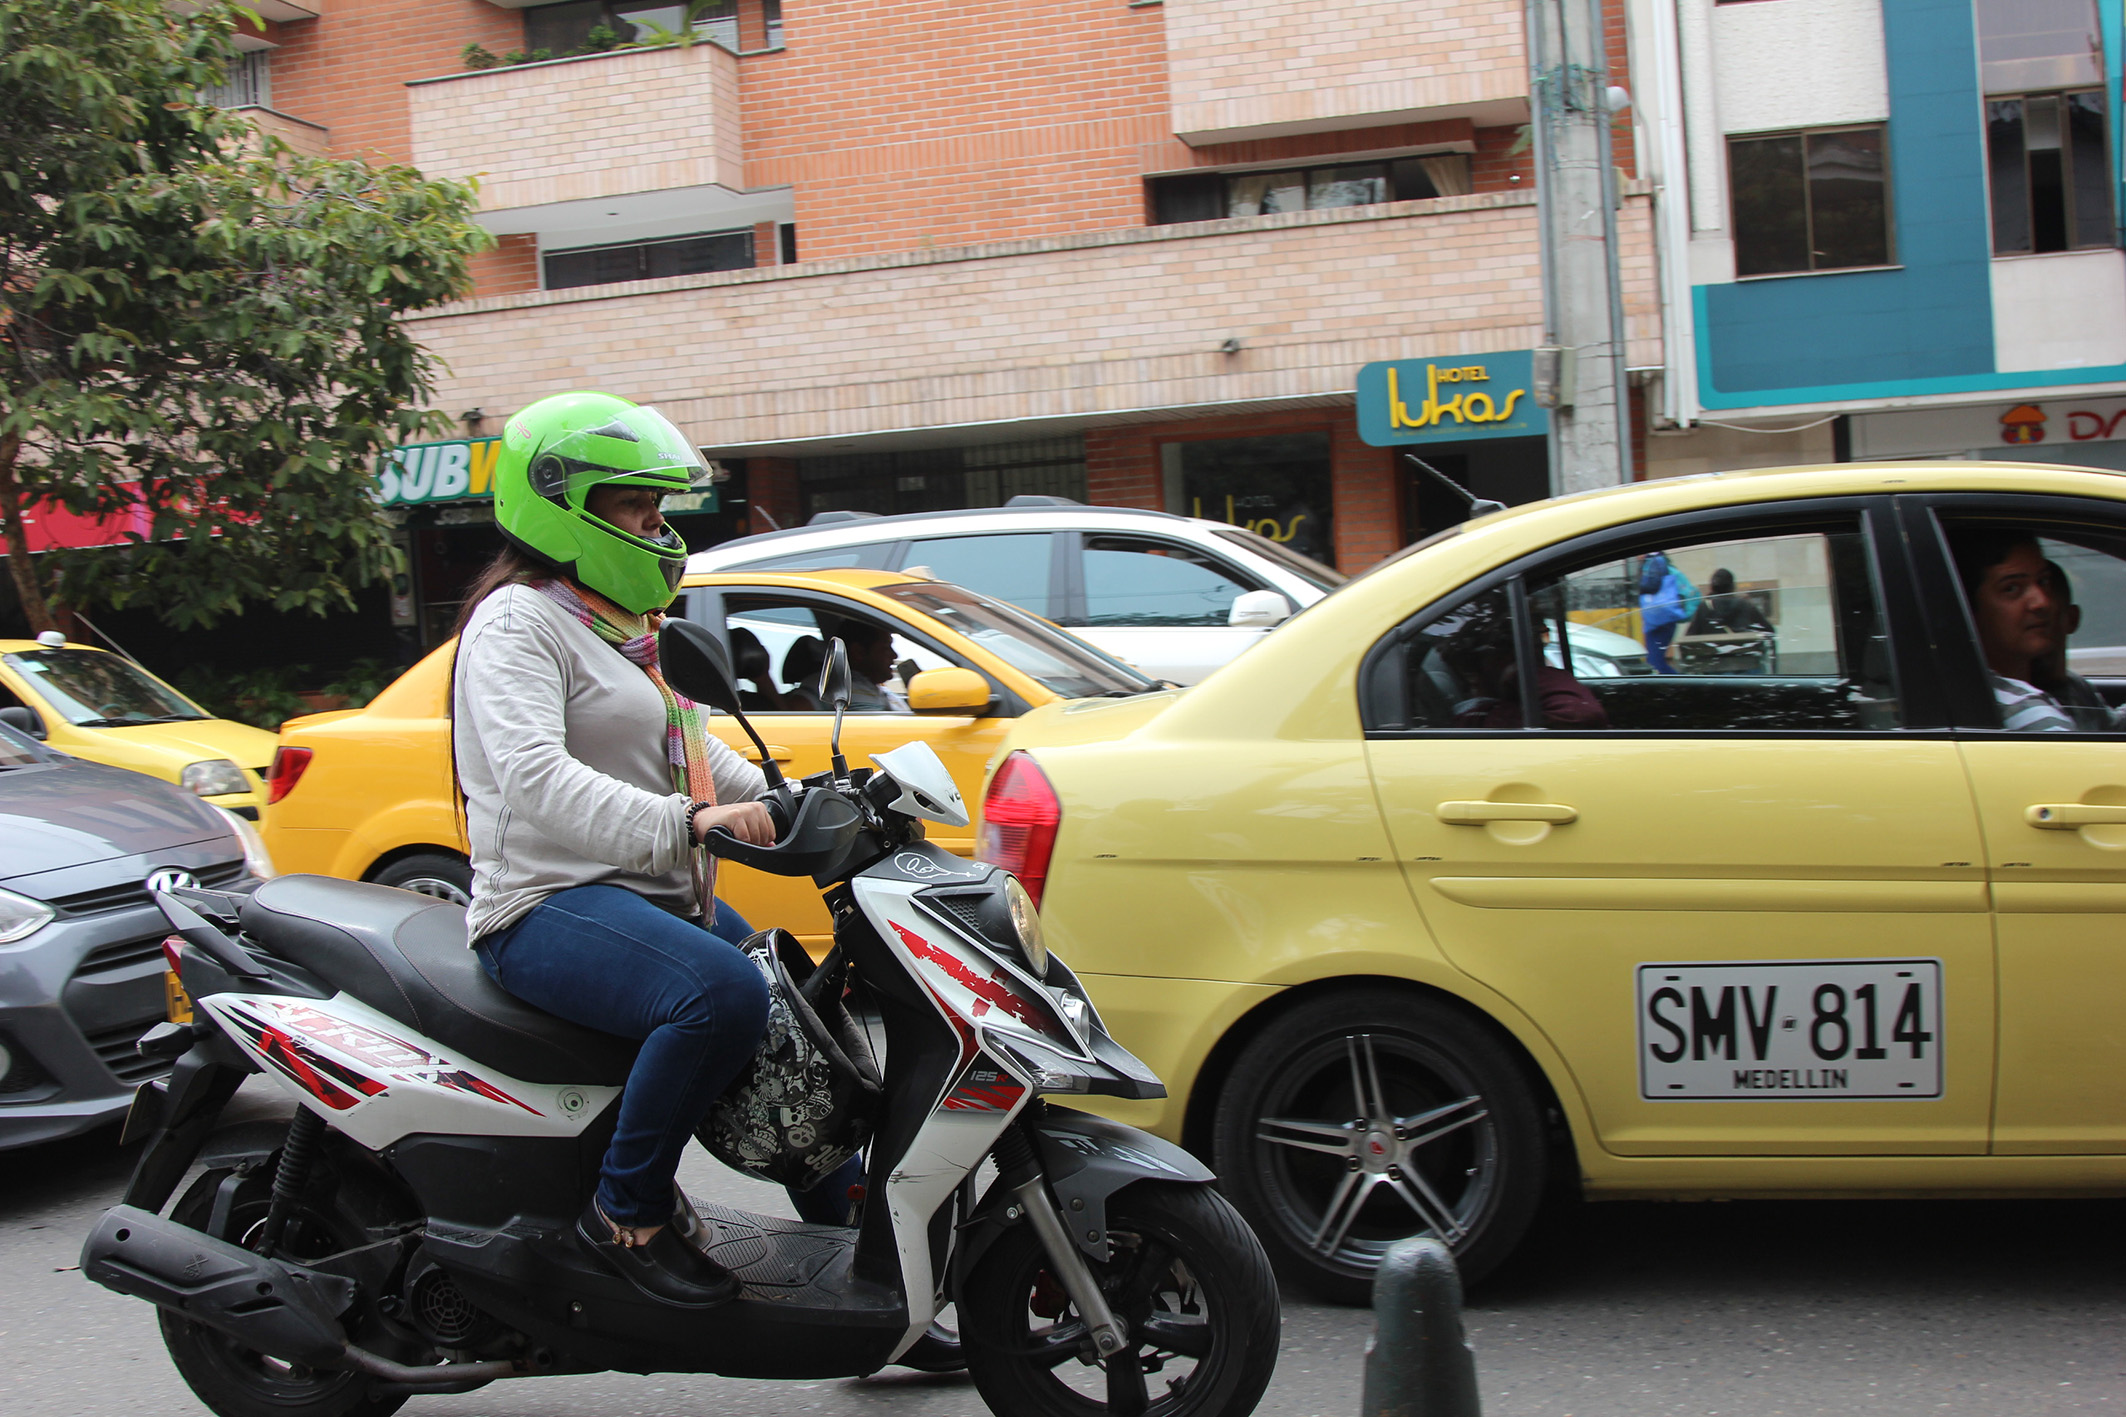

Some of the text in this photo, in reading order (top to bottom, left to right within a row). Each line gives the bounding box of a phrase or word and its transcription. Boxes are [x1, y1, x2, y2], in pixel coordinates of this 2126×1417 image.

[1437, 366, 1490, 383] HOTEL
[1387, 364, 1526, 429] lukas
[1810, 983, 1932, 1061] 814
[1733, 1069, 1848, 1089] MEDELLIN
